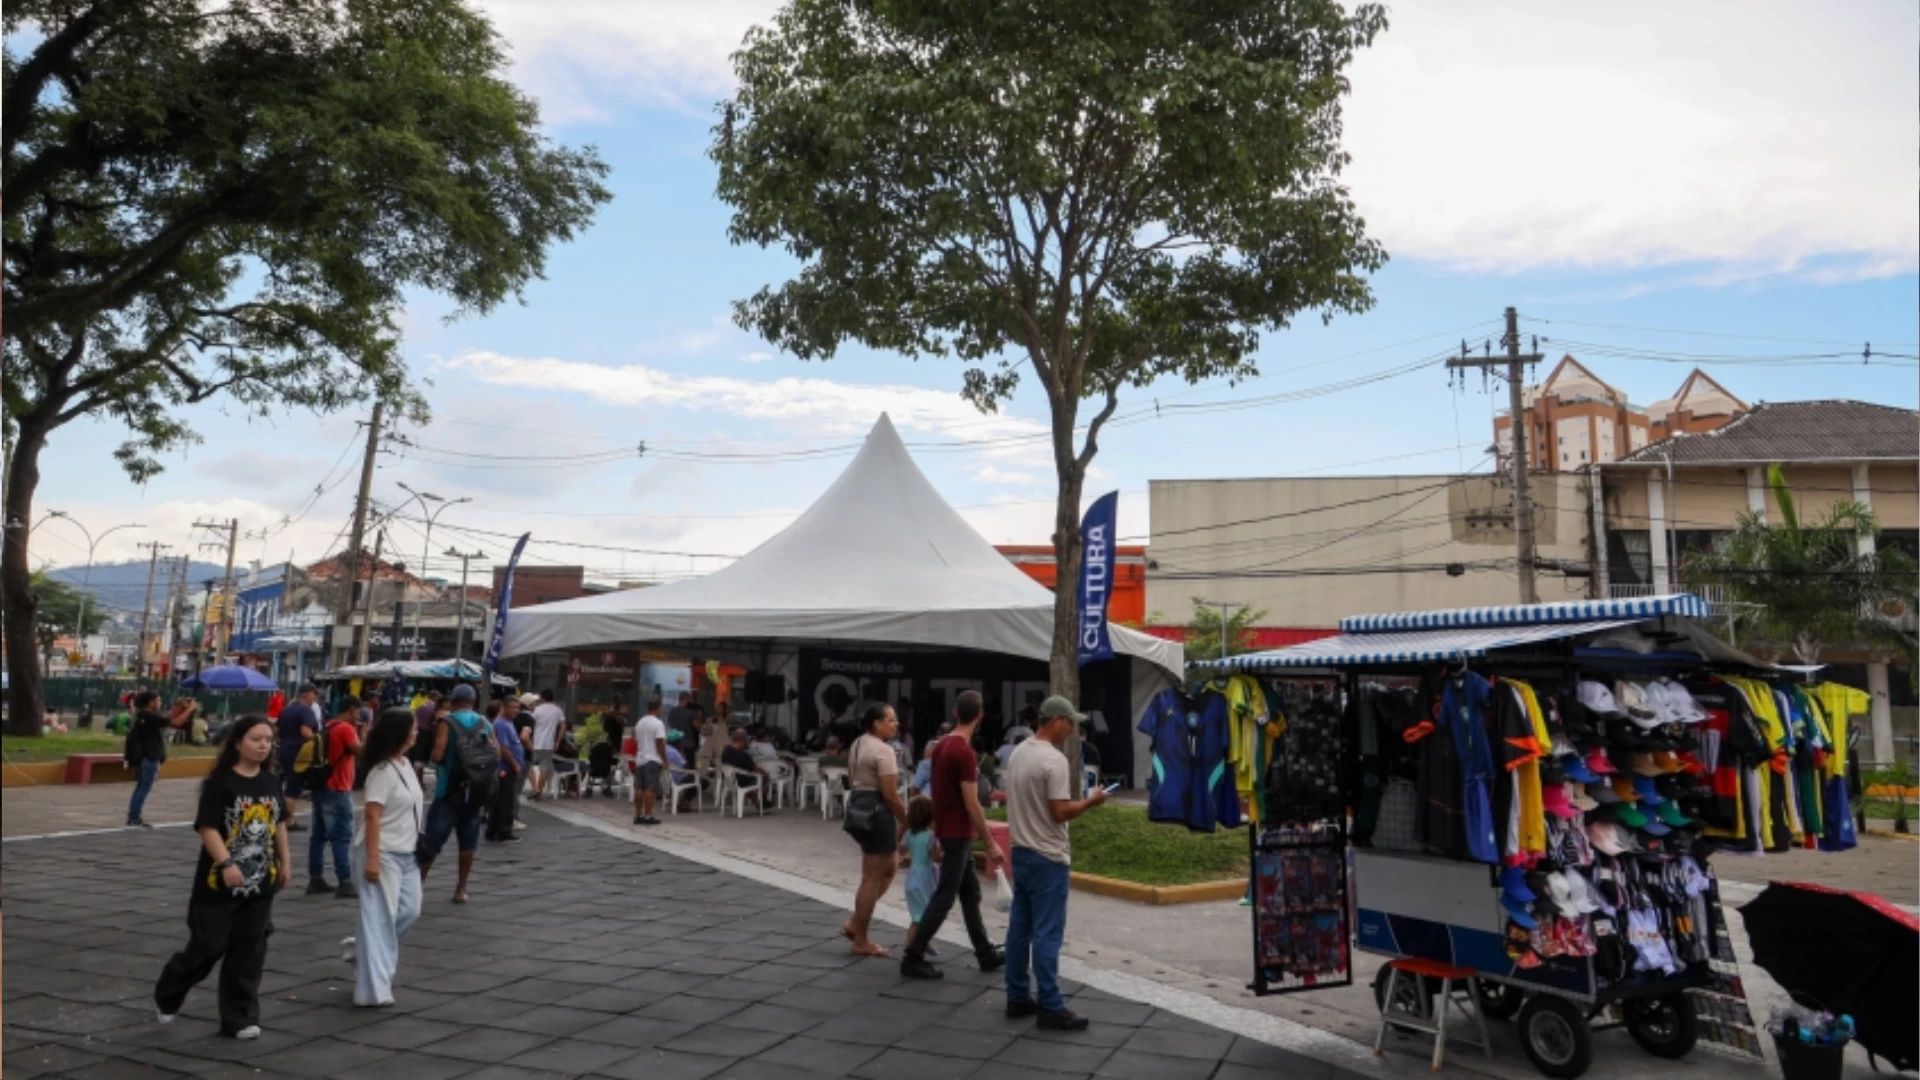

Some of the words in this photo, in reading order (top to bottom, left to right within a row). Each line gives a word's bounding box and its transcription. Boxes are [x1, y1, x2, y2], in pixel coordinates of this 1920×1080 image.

[1084, 524, 1107, 648] CULTURA
[820, 657, 885, 674] Secretaria
[887, 661, 904, 674] de
[813, 674, 1109, 734] CUTUR
